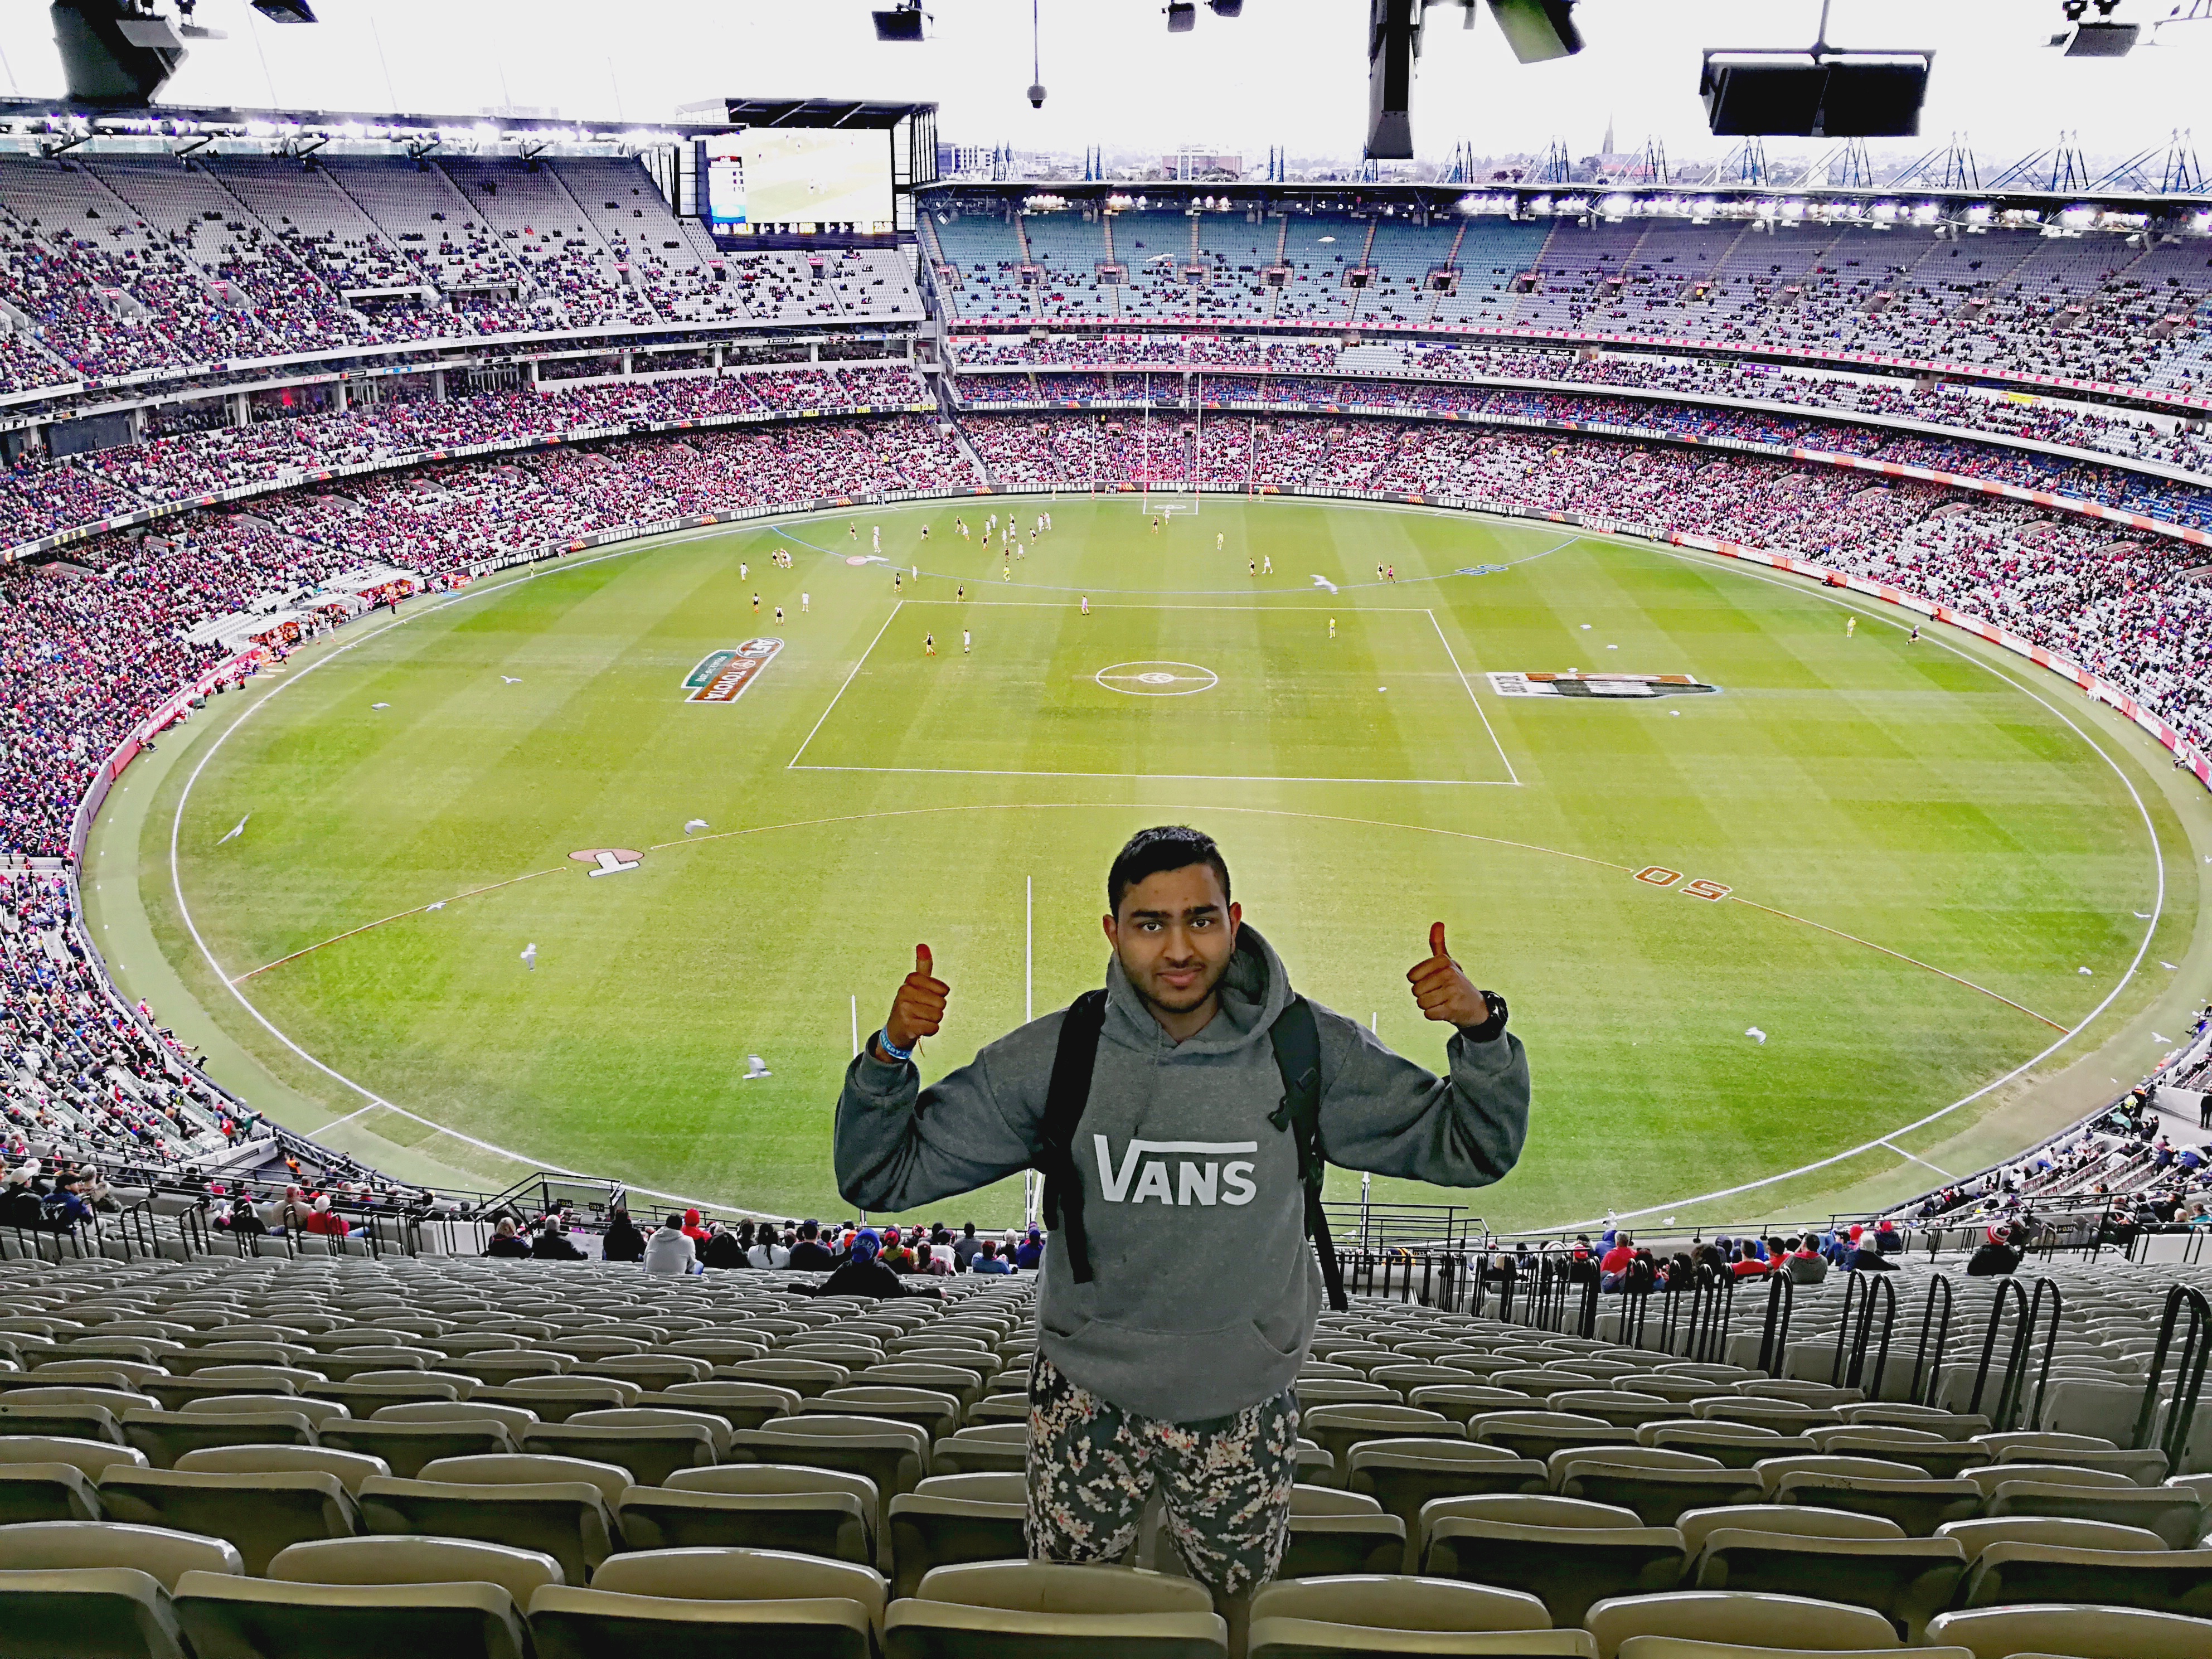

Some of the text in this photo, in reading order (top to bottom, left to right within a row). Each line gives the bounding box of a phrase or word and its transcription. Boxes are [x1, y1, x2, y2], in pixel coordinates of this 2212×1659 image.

[120, 373, 153, 385] ROBERT
[153, 368, 187, 380] FLOWER
[187, 365, 210, 376] WING
[1944, 385, 1966, 394] United
[973, 401, 1011, 409] KENNEDY
[1276, 402, 1309, 410] MOLLOY
[1349, 405, 1428, 417] KENNEDY MOLLOY
[700, 412, 775, 426] KENNEDY MOLLOY
[1468, 413, 1548, 426] KENNEDY MOLLOY
[568, 428, 606, 442] KENNEDY
[1588, 423, 1667, 439] KENNEDY MOLLOY
[455, 438, 532, 457] KENNEDY MOLLOY
[1708, 435, 1788, 455] KENNEDY MOLLOY
[339, 455, 419, 477] KENNEDY MOLLOY
[223, 476, 303, 501] KENNEDY MOLLOY
[916, 488, 953, 499] MOLLOY
[1007, 483, 1049, 492] KENNEDY
[1202, 483, 1240, 492] MOLLOY
[1294, 486, 1385, 500] KENNEDY MOLLOY
[730, 506, 772, 520] KENNEDY
[598, 521, 681, 545] KENNEDY MOLLOY
[1456, 564, 1508, 576] 50
[744, 638, 777, 657] AFL
[704, 670, 748, 700] TOYOTA
[1093, 1134, 1258, 1205] VANS
